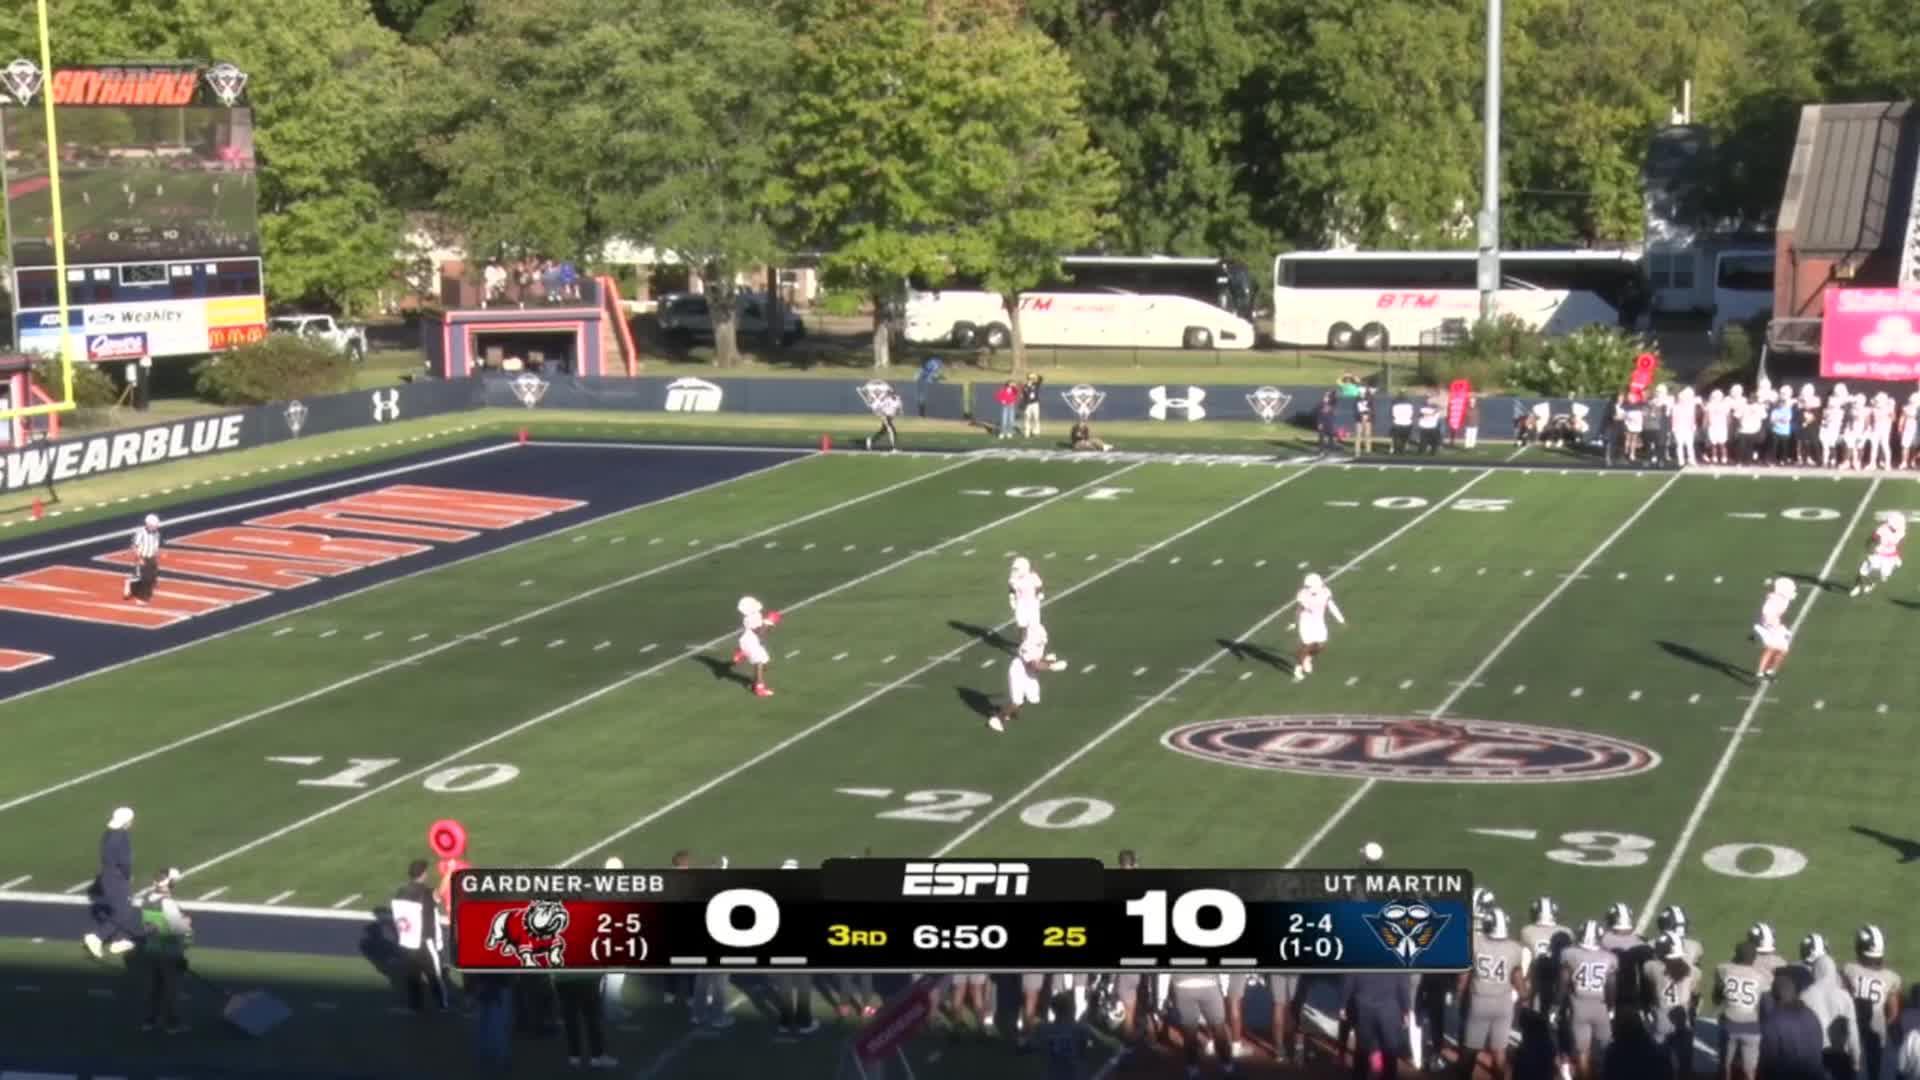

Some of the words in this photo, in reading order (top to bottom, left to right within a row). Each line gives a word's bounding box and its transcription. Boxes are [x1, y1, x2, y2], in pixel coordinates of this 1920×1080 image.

[53, 69, 198, 104] SKYHAWKS
[1376, 292, 1439, 309] BTM
[1256, 730, 1553, 767] OVC
[1477, 959, 1507, 984] 54
[1574, 962, 1607, 990] 45
[1726, 976, 1755, 1006] 25
[1855, 974, 1882, 1003] 16
